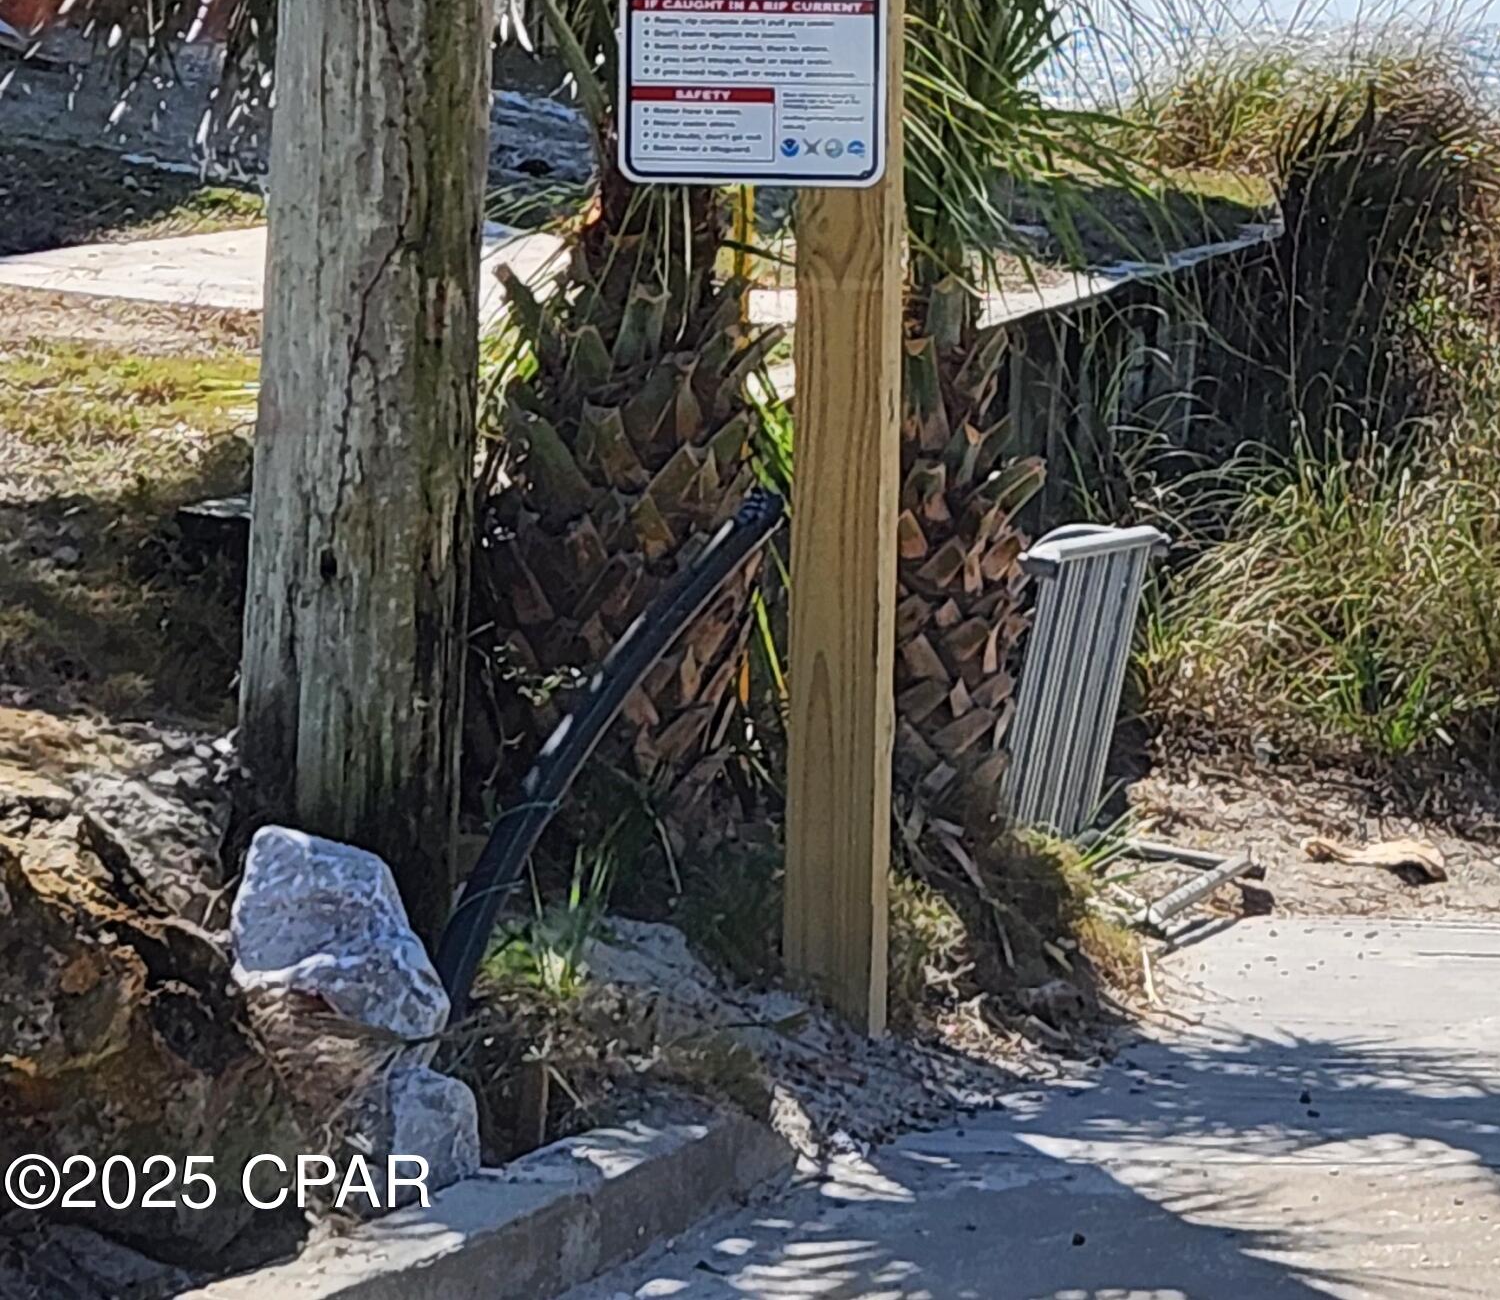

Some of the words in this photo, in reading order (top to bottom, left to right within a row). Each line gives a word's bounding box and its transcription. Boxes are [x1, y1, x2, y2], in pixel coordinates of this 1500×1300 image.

[644, 0, 656, 10] IF
[662, 0, 725, 11] CAUGHT
[728, 0, 744, 11] IN
[748, 0, 760, 11] A
[763, 1, 788, 12] RIP
[792, 1, 863, 13] CURRENT
[675, 89, 732, 101] SAFETY
